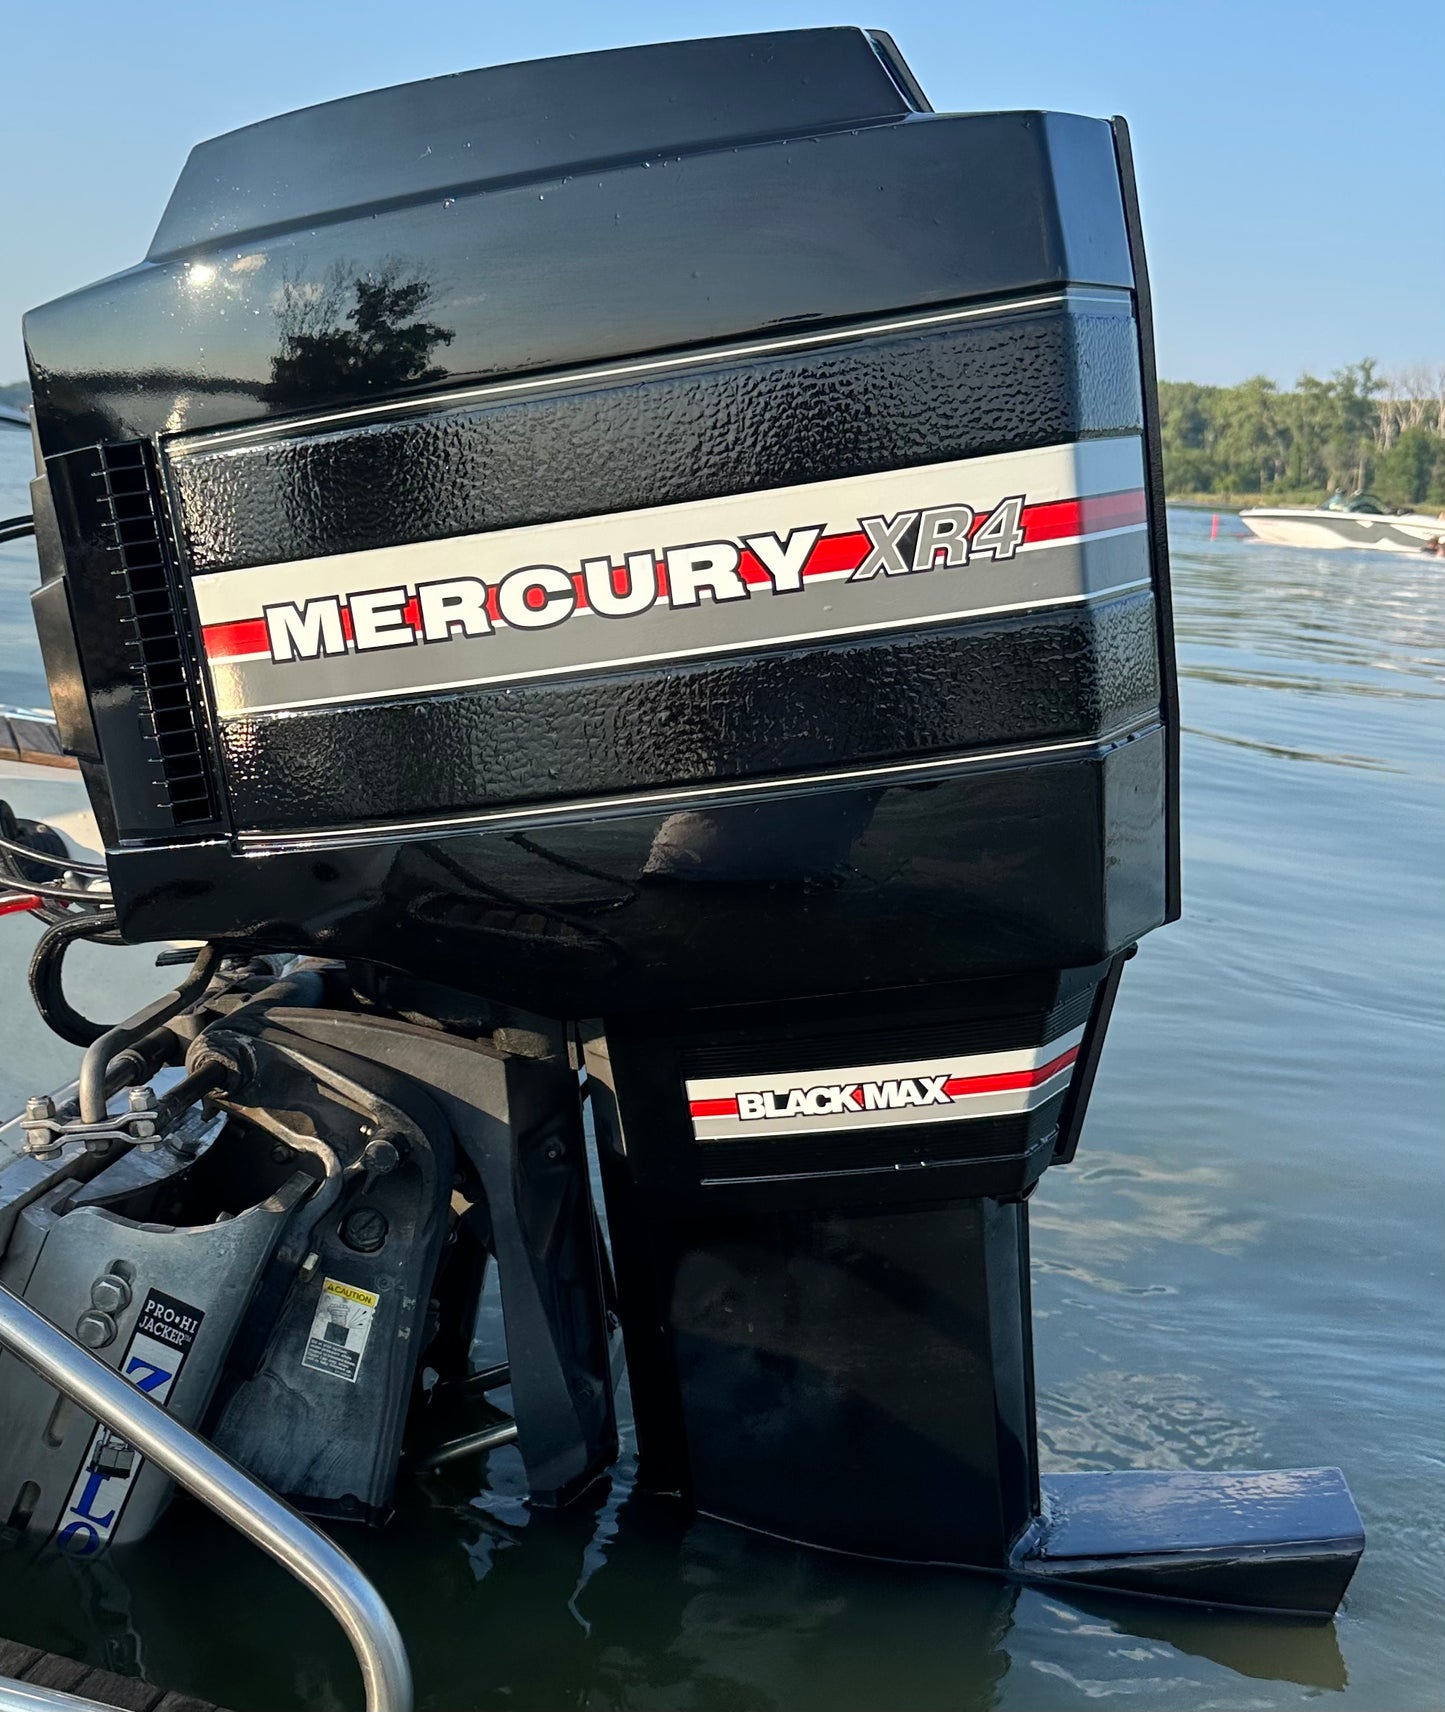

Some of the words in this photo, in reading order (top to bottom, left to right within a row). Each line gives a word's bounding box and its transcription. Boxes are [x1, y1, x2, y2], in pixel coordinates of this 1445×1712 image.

[263, 525, 825, 663] MERCURY
[852, 494, 1027, 583] XR4
[735, 1084, 861, 1121] BLACK
[861, 1074, 956, 1111] MAX
[335, 1286, 372, 1304] CAUTION
